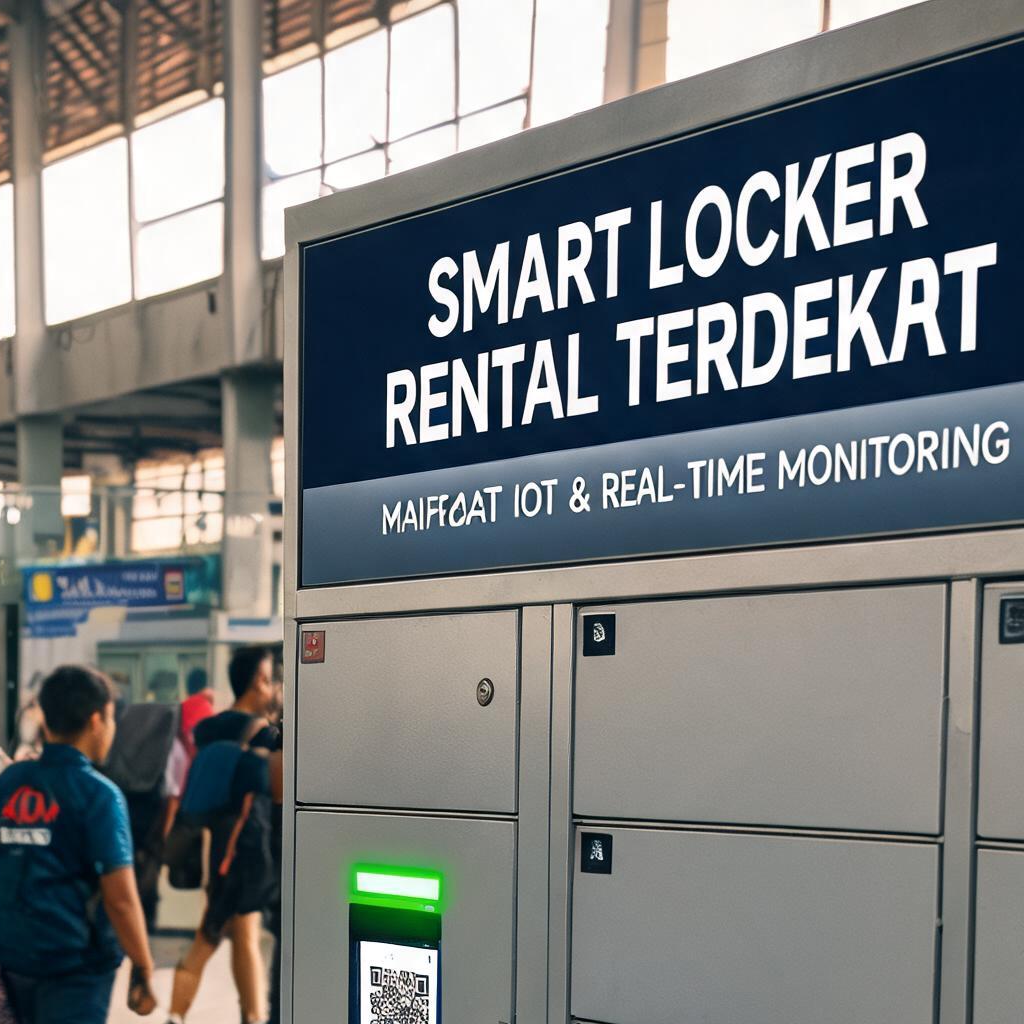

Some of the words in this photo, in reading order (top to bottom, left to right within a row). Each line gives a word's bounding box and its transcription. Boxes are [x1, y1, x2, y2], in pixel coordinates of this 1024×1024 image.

[427, 207, 632, 338] SMART
[649, 132, 929, 290] LOCKER
[386, 332, 599, 449] RENTAL
[514, 478, 559, 518] IOT
[568, 476, 591, 513] &
[602, 453, 766, 510] REAL-TIME
[778, 420, 1010, 490] MONITORING
